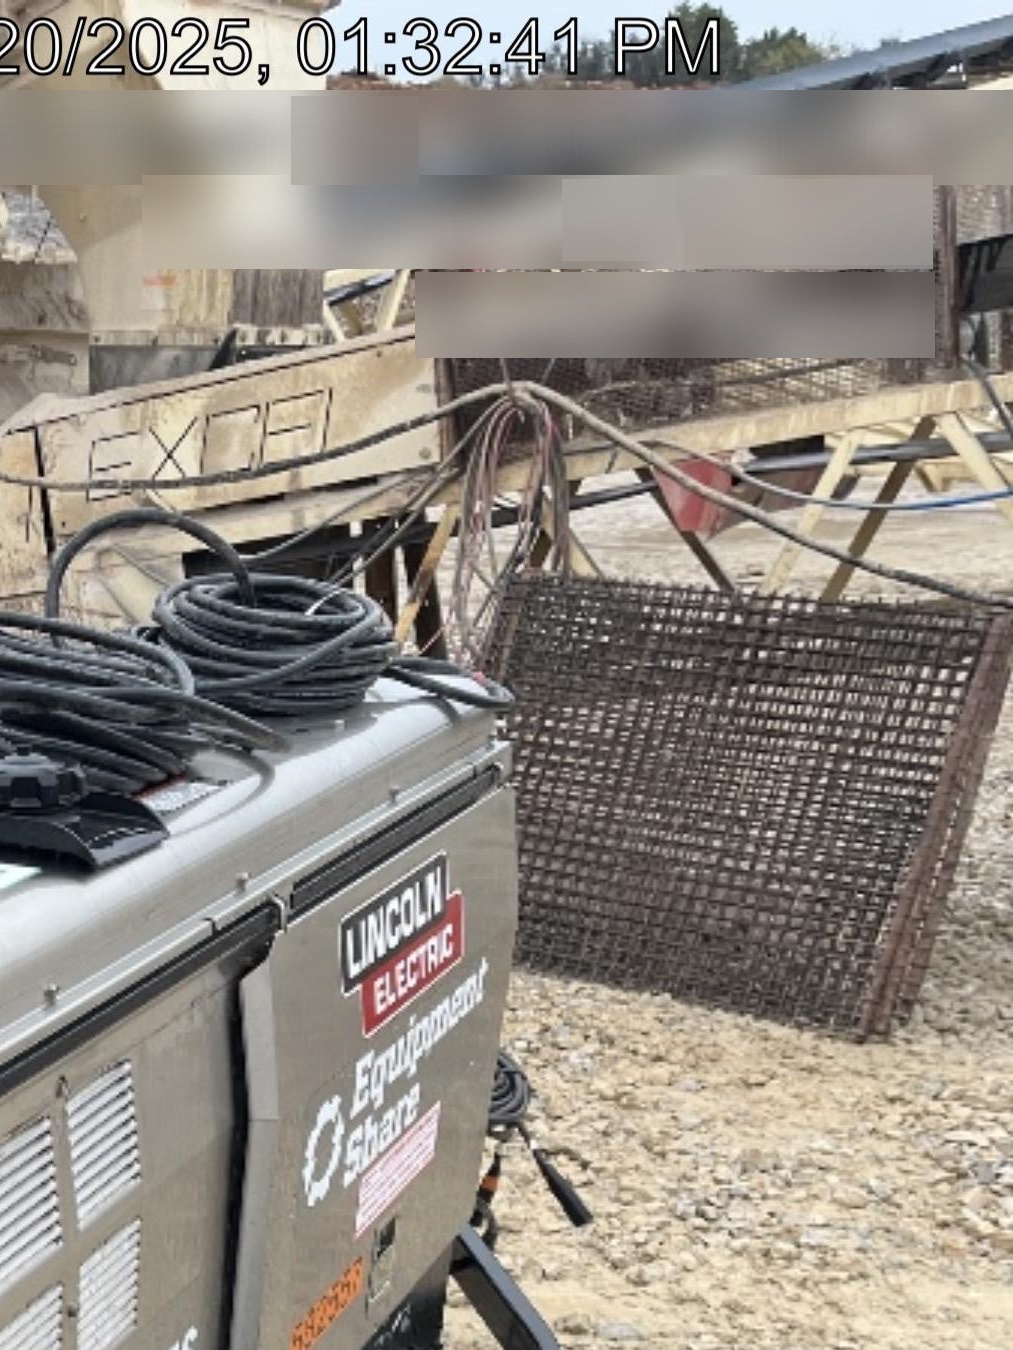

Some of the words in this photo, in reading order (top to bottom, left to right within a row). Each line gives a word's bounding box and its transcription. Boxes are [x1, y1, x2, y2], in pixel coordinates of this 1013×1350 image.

[346, 866, 443, 979] LINCOLN
[372, 922, 454, 1016] ELECTRIC
[350, 956, 489, 1120] Equipment
[343, 1082, 420, 1189] Share
